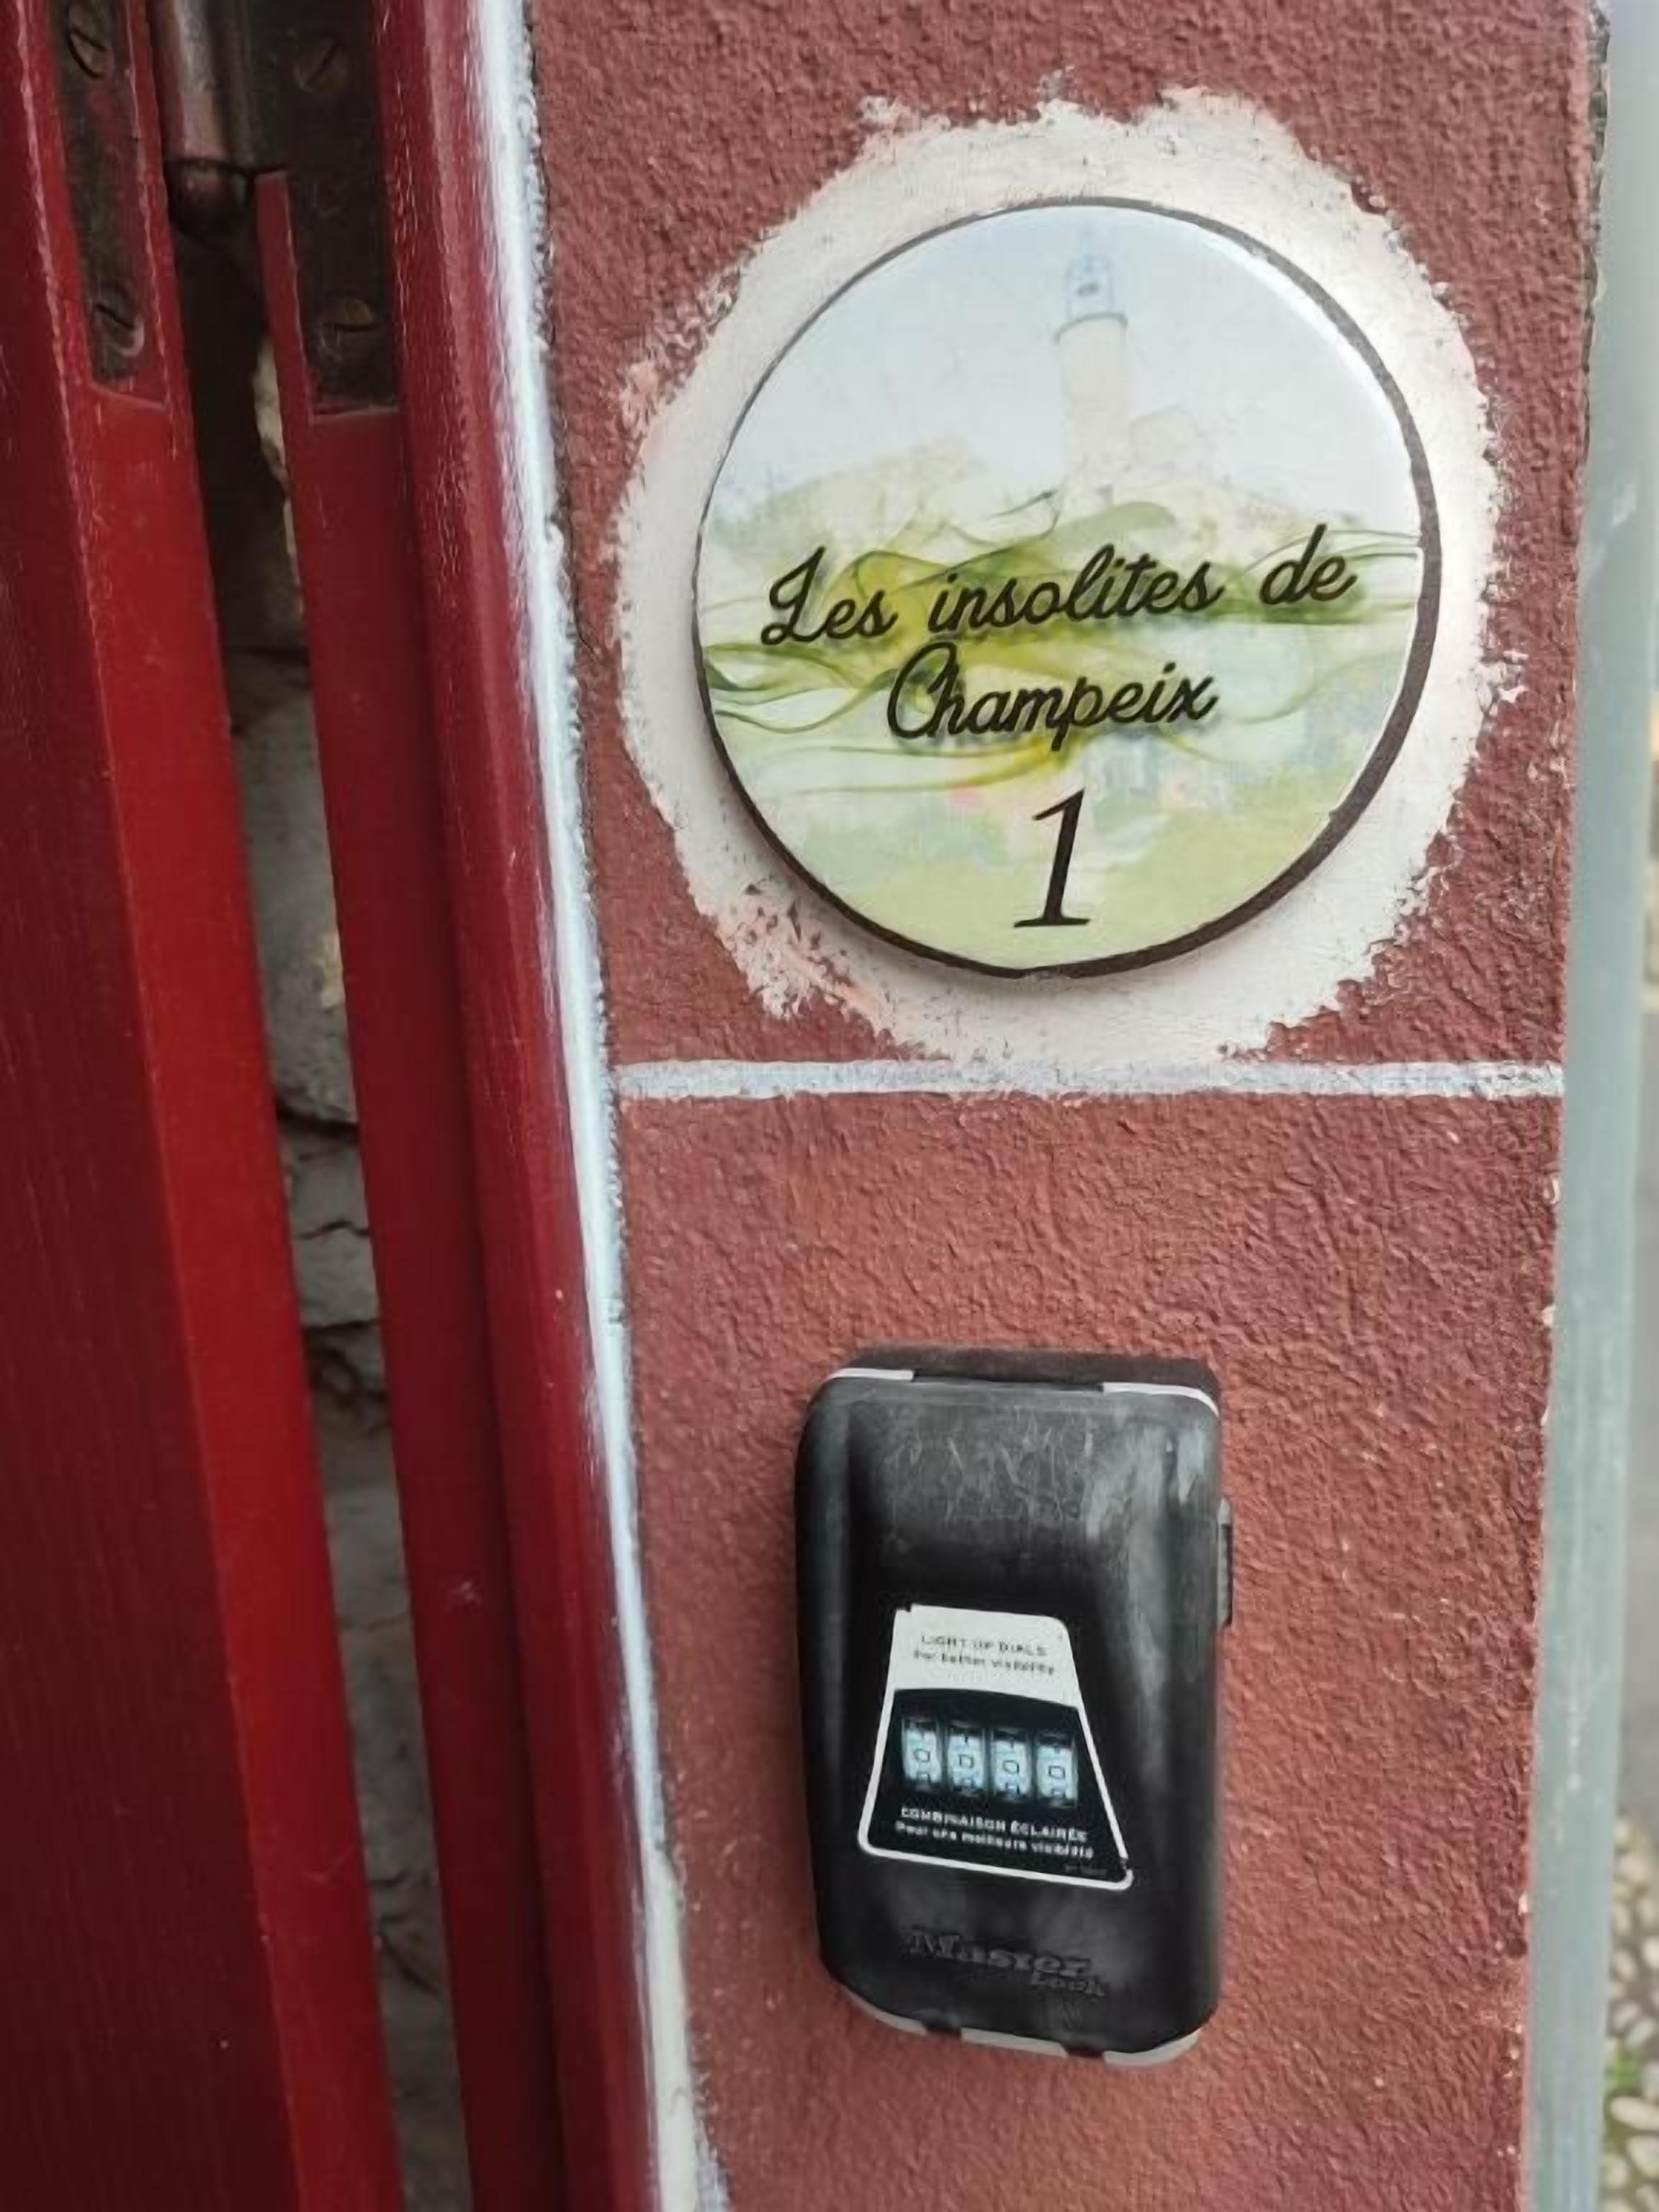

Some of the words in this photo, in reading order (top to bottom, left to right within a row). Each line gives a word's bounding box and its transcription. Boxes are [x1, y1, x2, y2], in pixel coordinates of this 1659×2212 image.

[760, 546, 899, 646] Les
[927, 543, 1226, 635] insolites
[1259, 523, 1359, 606] de
[888, 641, 1220, 752] Champeix
[1013, 788, 1091, 929] 1
